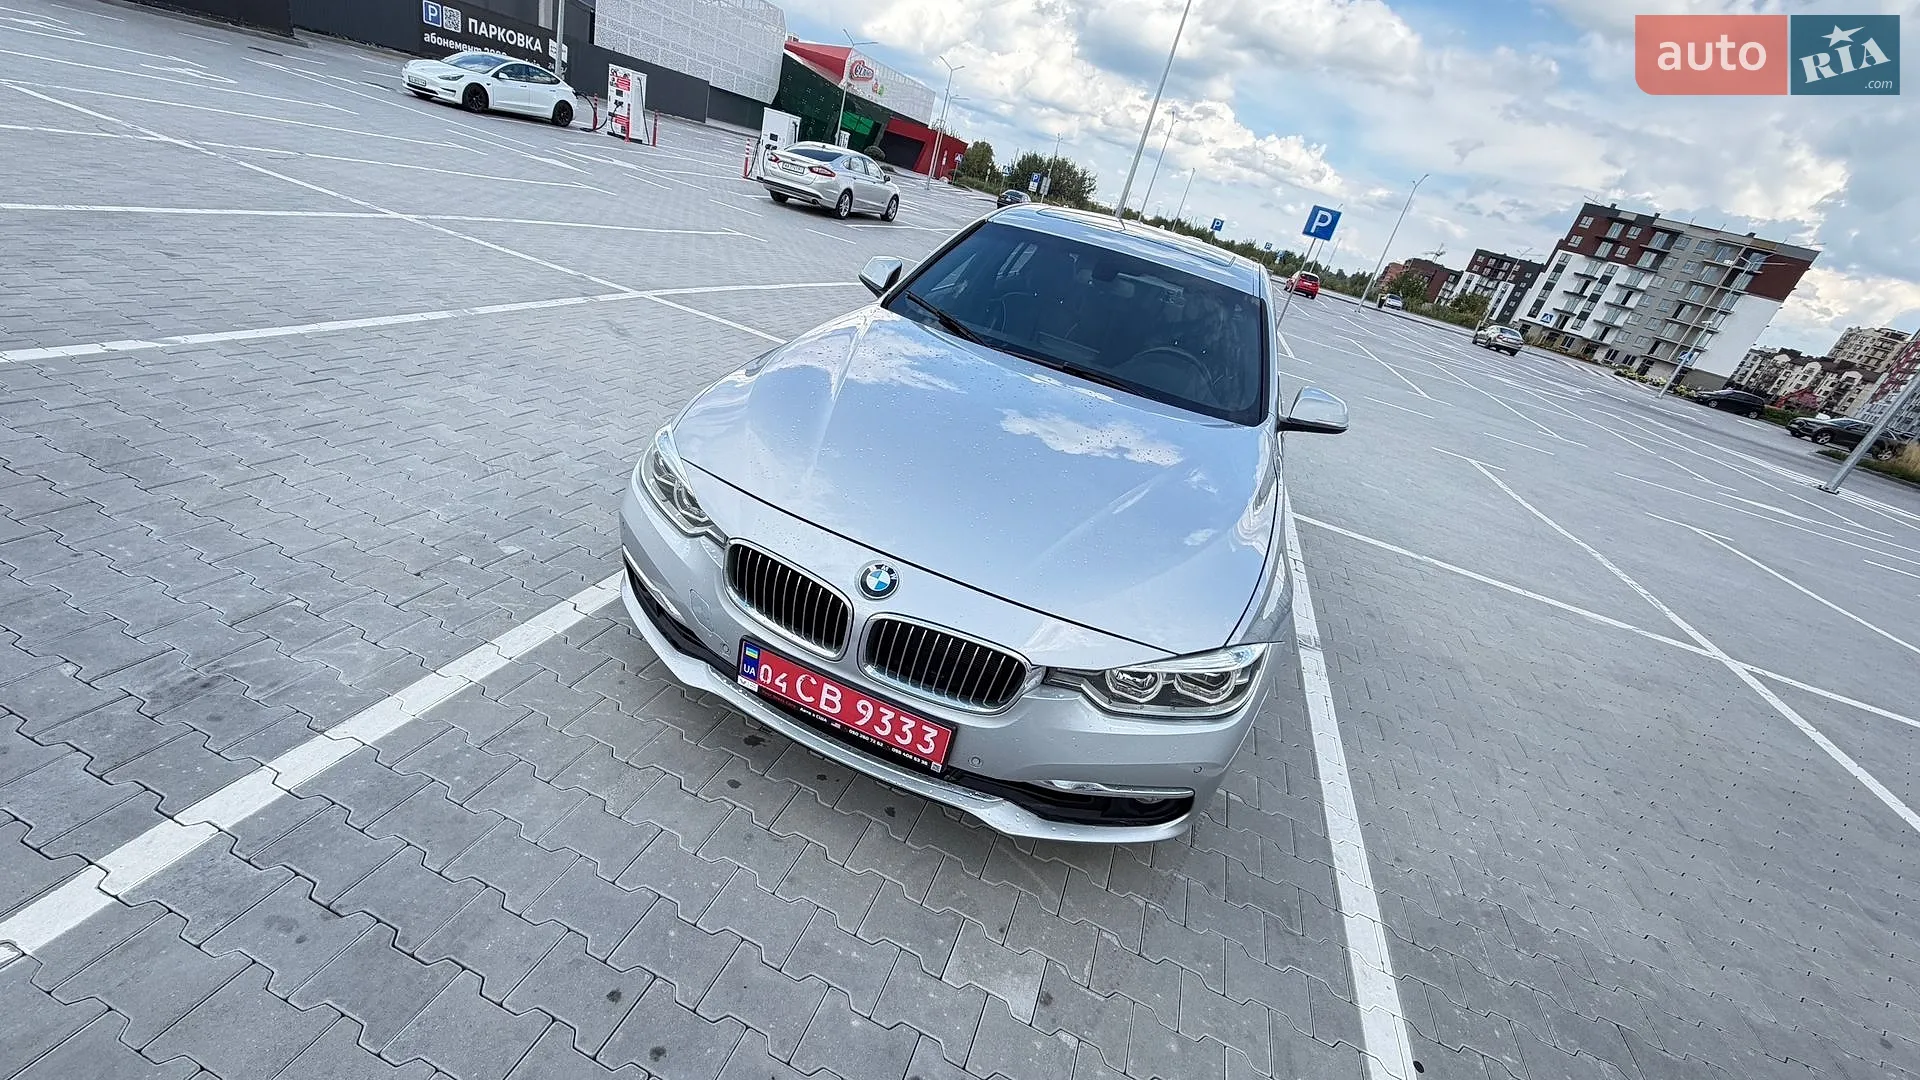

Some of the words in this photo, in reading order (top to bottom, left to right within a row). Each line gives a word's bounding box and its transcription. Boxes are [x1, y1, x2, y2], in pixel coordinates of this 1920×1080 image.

[468, 17, 543, 54] ПАРКОВКА
[1310, 209, 1333, 234] P
[868, 565, 898, 580] BMW
[743, 663, 756, 677] UA
[760, 664, 788, 694] 04
[855, 699, 938, 755] 9333
